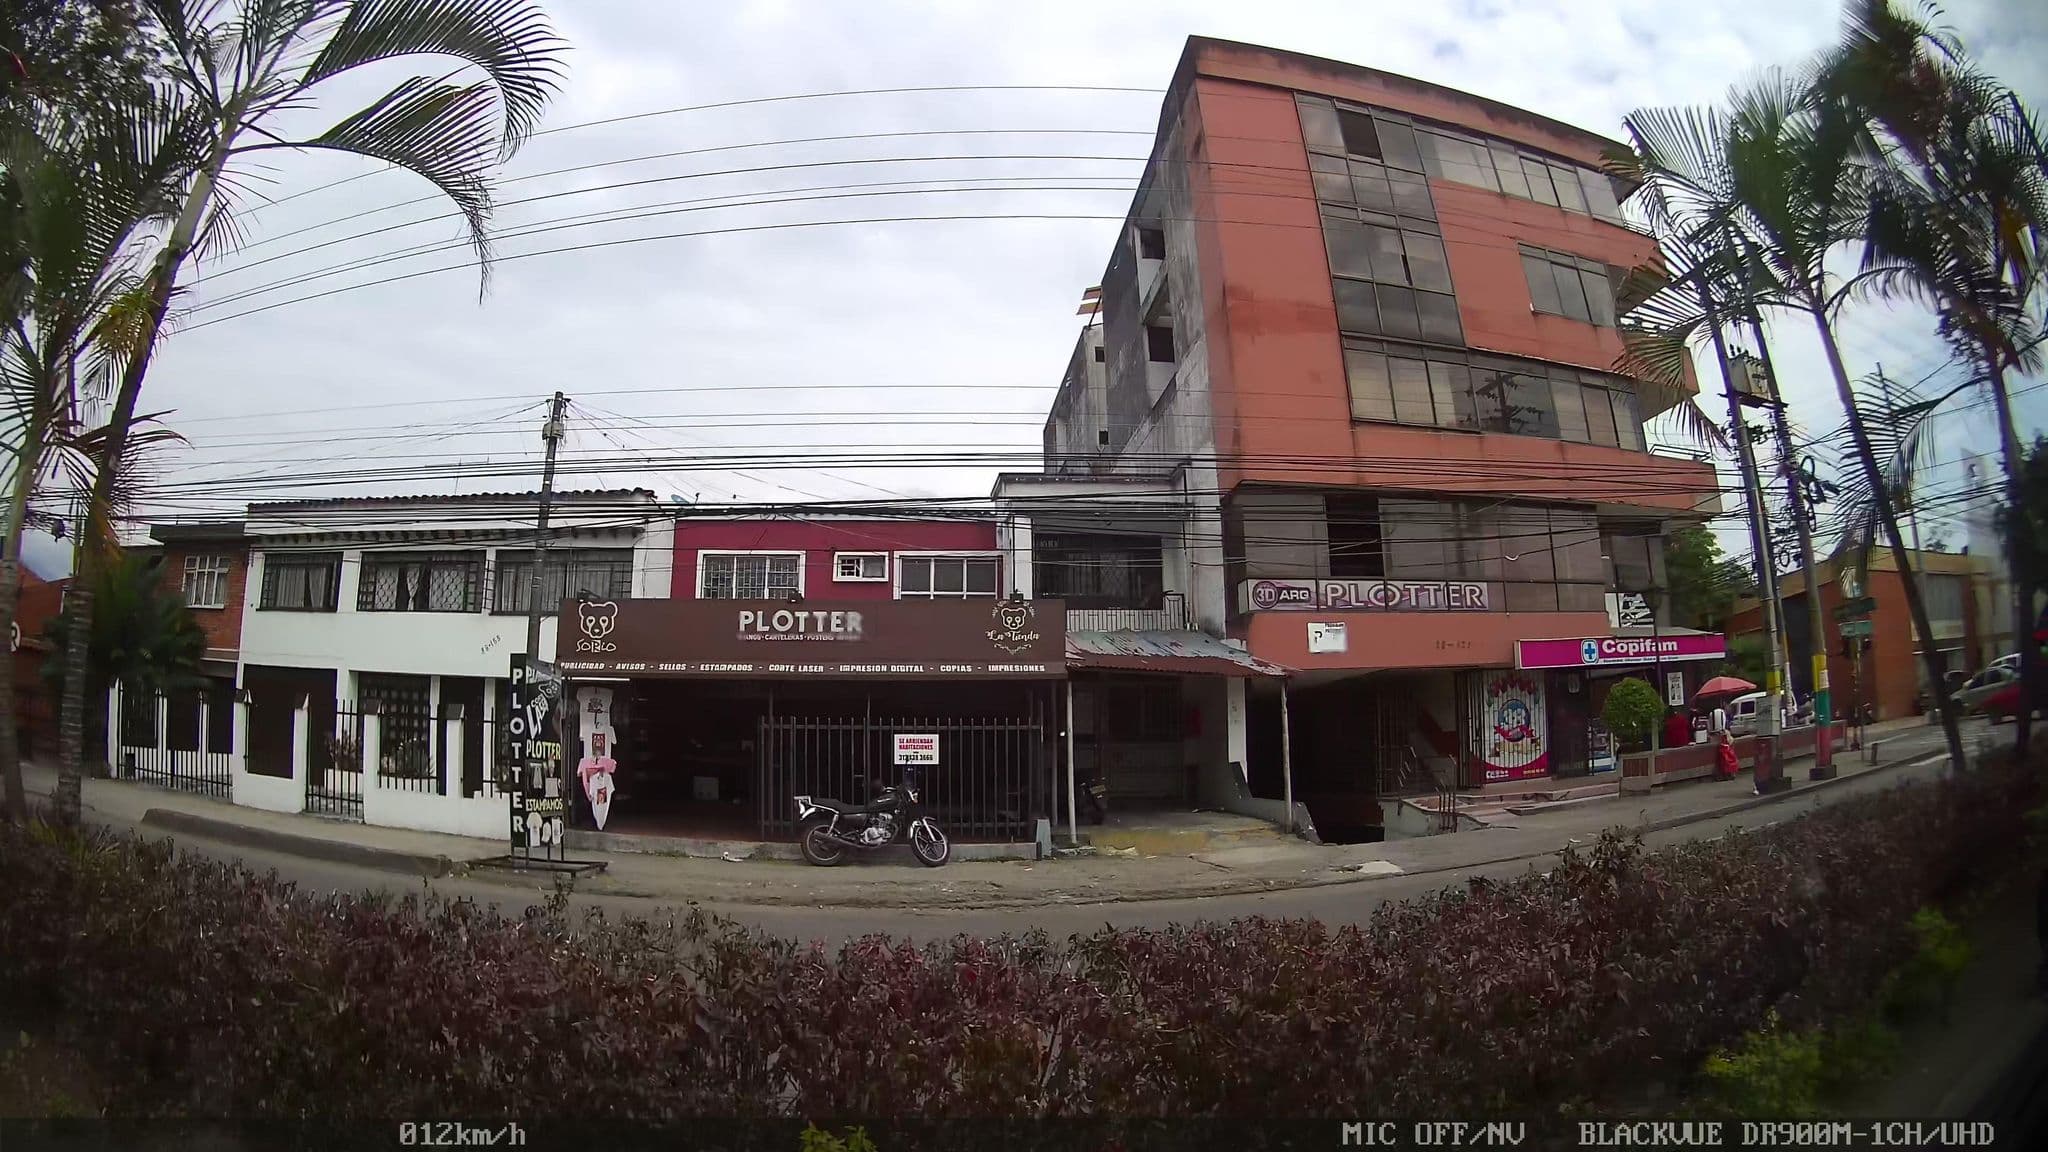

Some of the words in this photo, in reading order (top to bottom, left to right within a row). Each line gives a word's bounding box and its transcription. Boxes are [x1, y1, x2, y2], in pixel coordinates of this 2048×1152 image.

[1325, 583, 1488, 609] PLOTTER
[739, 610, 862, 632] PLOTTER
[1602, 639, 1678, 656] Copifam
[658, 663, 687, 671] SELLOS
[700, 663, 753, 672] ESTAMPADOS
[840, 665, 887, 673] IMPRESION
[891, 665, 924, 673] DIGITAL
[510, 667, 526, 833] PLOTTER
[526, 739, 561, 760] PLOTTER
